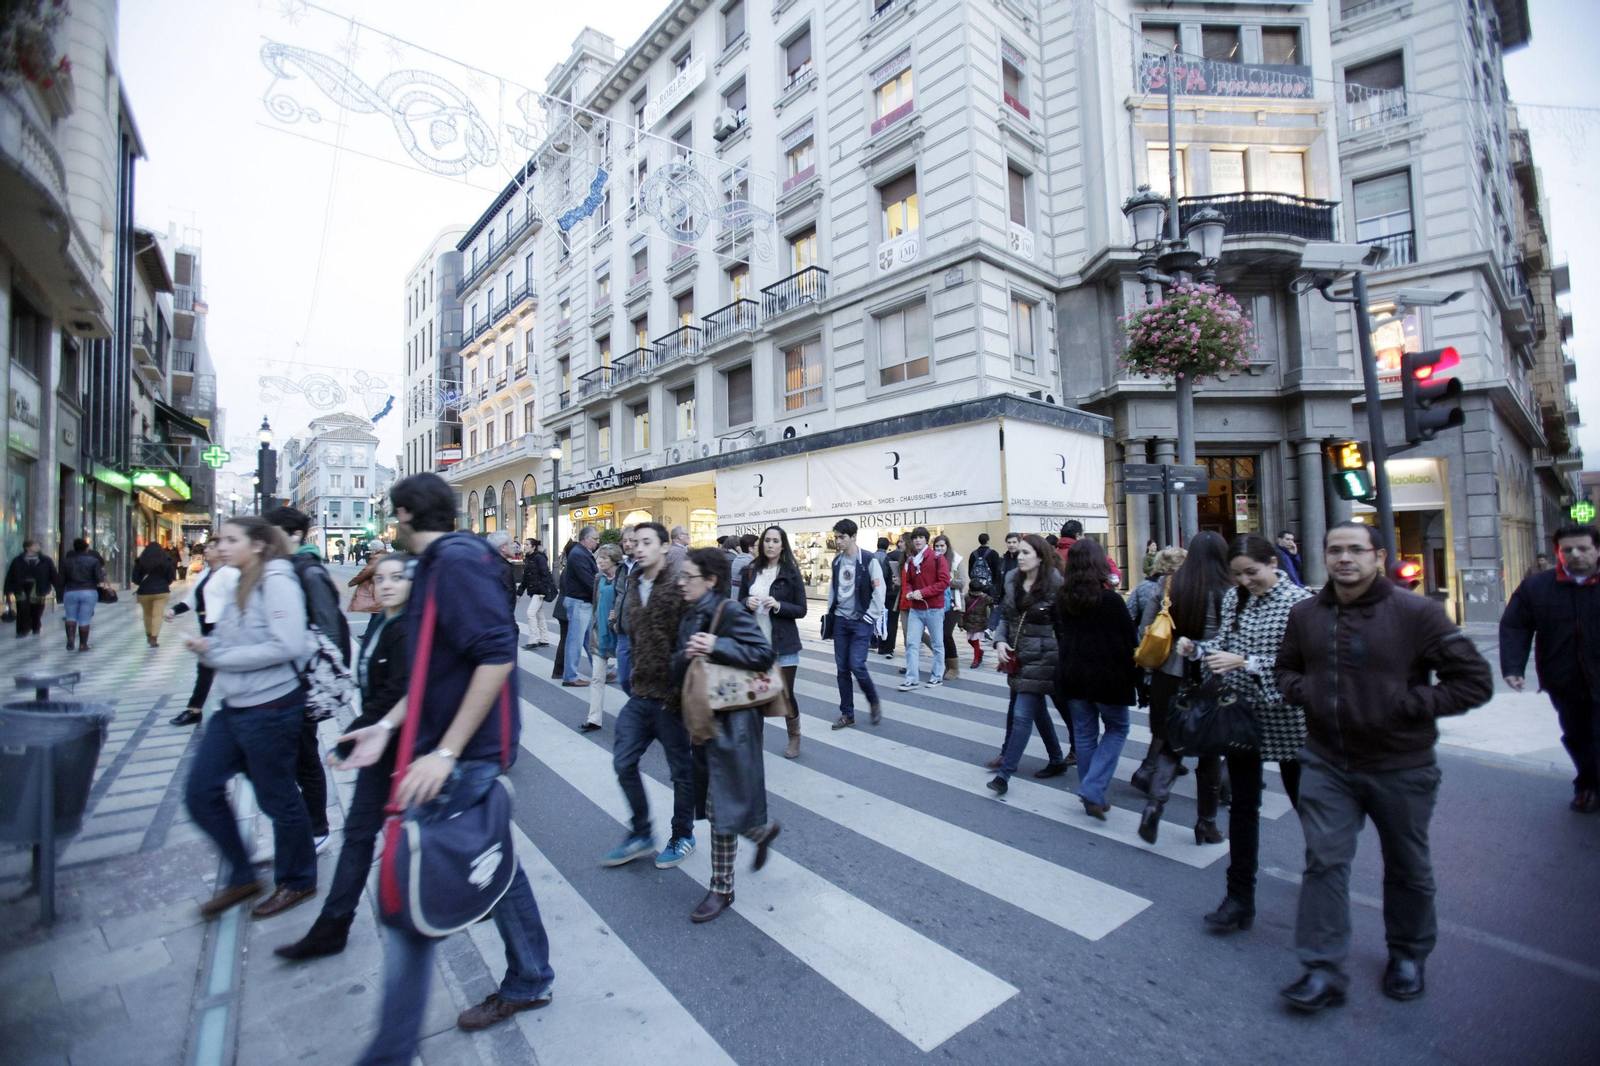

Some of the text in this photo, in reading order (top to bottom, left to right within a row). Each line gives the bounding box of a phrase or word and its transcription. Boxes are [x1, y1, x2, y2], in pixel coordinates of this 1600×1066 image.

[660, 73, 687, 105] ROBLES
[831, 489, 967, 509] ZAPATOS SCHUE SHOES CHAUSSURES SCARPE
[1011, 498, 1030, 506] ZAPATOS
[1034, 499, 1047, 507] SCHUE
[859, 510, 928, 529] ROSSELLI
